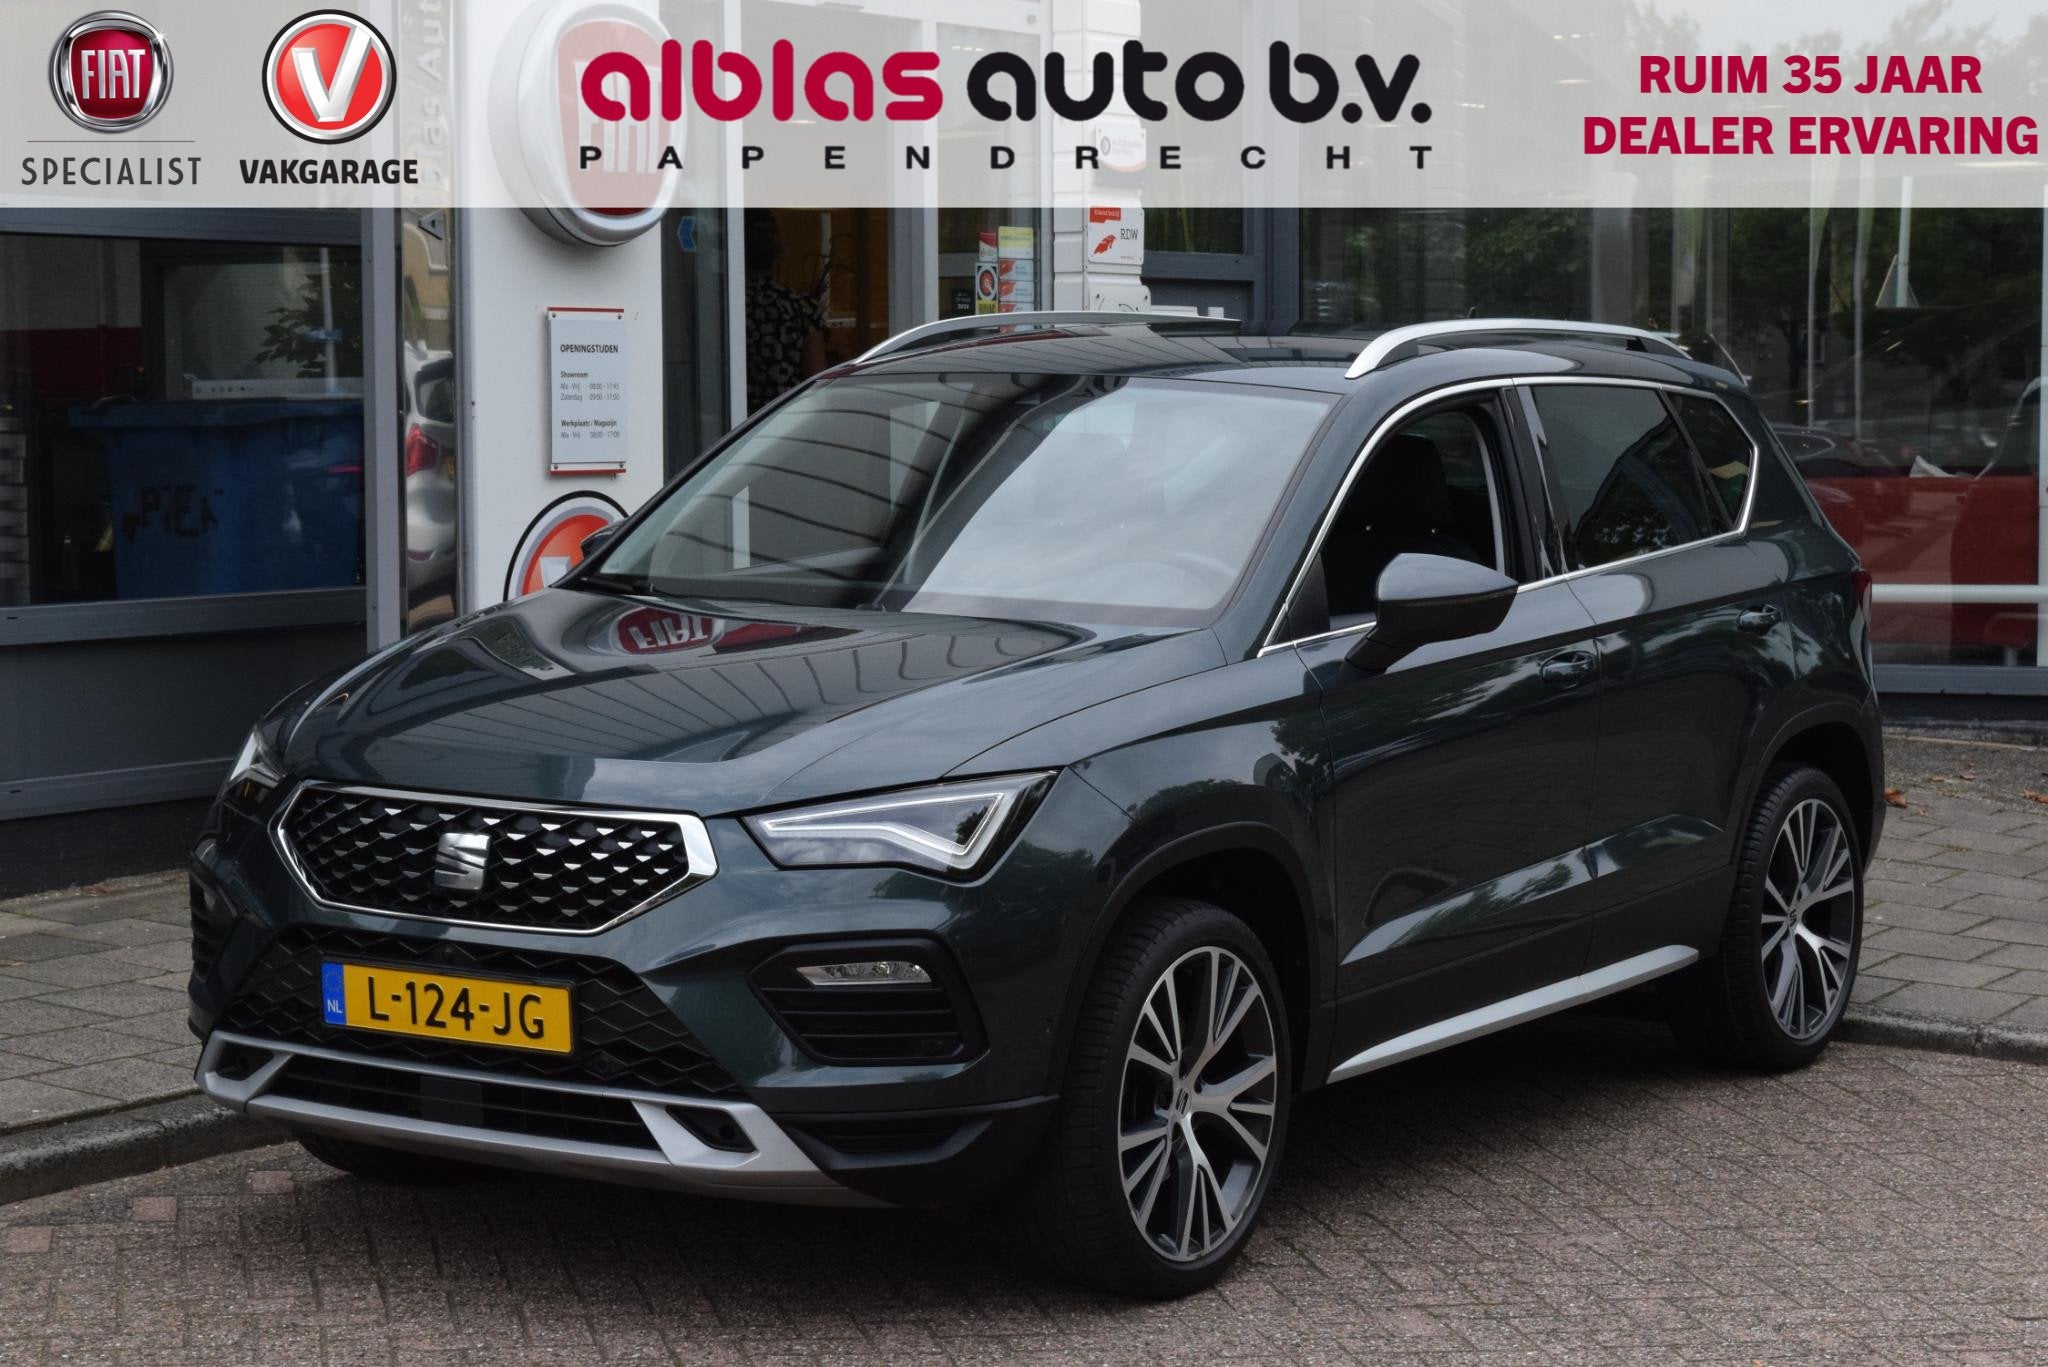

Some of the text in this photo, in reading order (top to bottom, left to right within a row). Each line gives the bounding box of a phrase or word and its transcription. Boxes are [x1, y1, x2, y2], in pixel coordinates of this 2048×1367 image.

[417, 0, 443, 82] Aut
[1120, 228, 1139, 240] RDW
[326, 998, 344, 1015] NL
[367, 975, 545, 1040] L-124-JG
